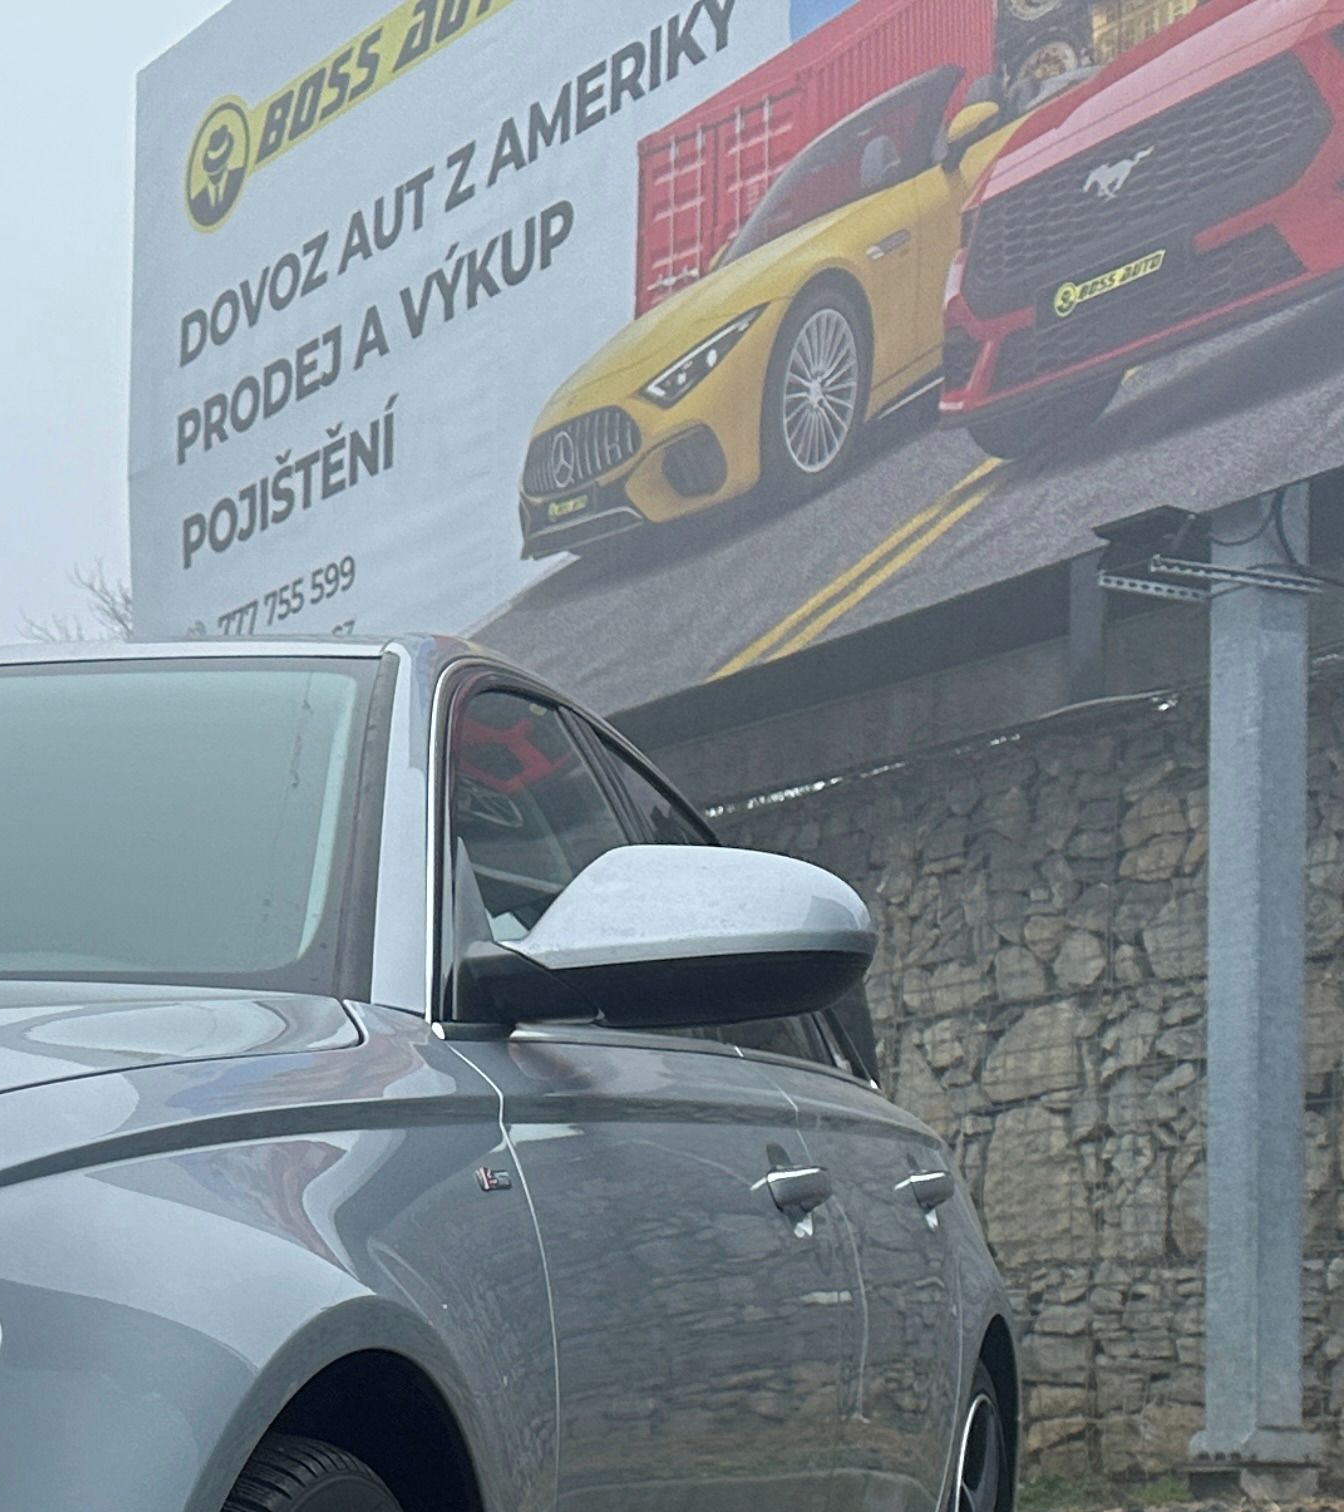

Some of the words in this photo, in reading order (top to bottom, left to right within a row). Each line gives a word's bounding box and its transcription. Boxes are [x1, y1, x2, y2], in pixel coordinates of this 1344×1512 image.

[256, 26, 384, 165] BOSS
[392, 0, 494, 73] AU
[179, 230, 329, 368] DOVOZ
[337, 166, 435, 275] AUT
[444, 140, 477, 213] Z
[486, 0, 735, 189] AMERIKY
[177, 324, 342, 466] PRODEJ
[353, 304, 390, 371] A
[399, 199, 574, 340] VÝKUP
[183, 392, 399, 570] POJIŠTĚNÍ
[264, 577, 305, 627] 755
[309, 555, 356, 605] 599
